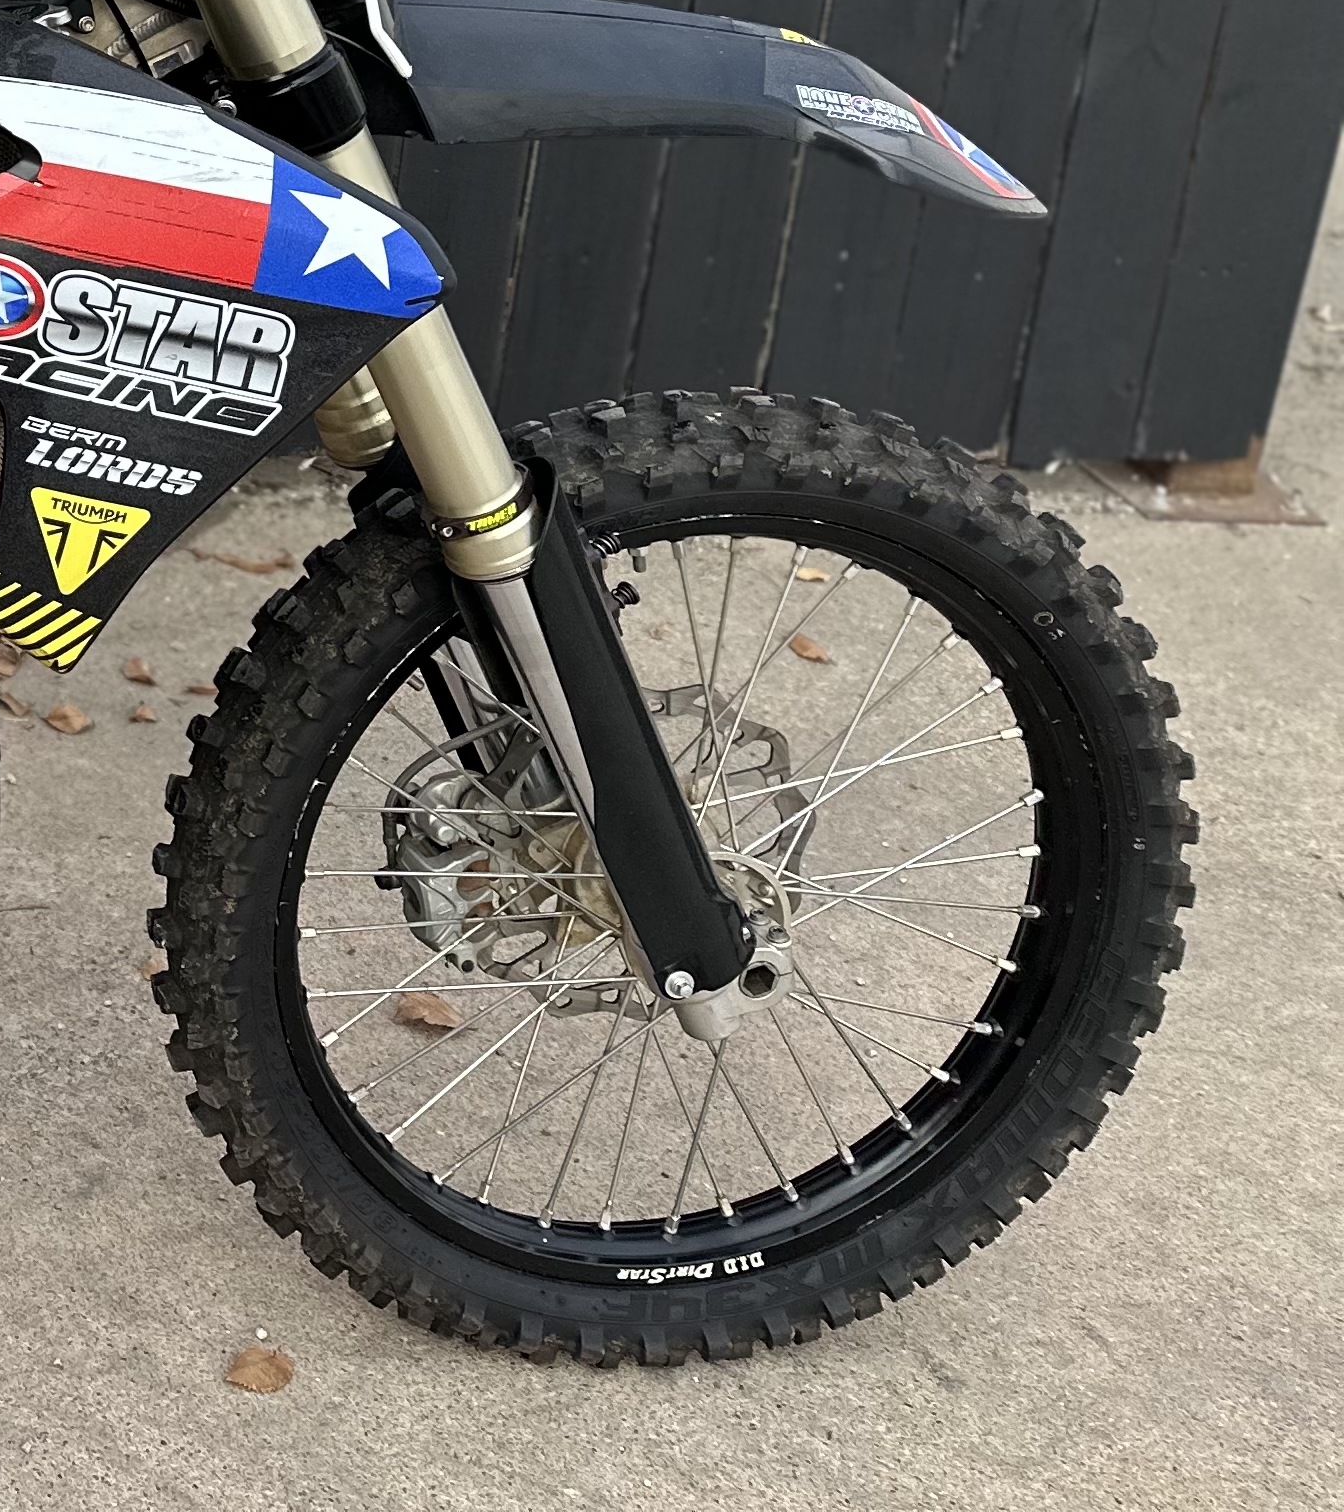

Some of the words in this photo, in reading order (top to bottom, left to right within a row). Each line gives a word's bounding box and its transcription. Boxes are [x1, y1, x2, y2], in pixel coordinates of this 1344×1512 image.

[42, 270, 296, 401] STAR
[20, 414, 128, 452] BERM
[24, 437, 204, 497] LORDS
[50, 497, 128, 525] TRIUMPH
